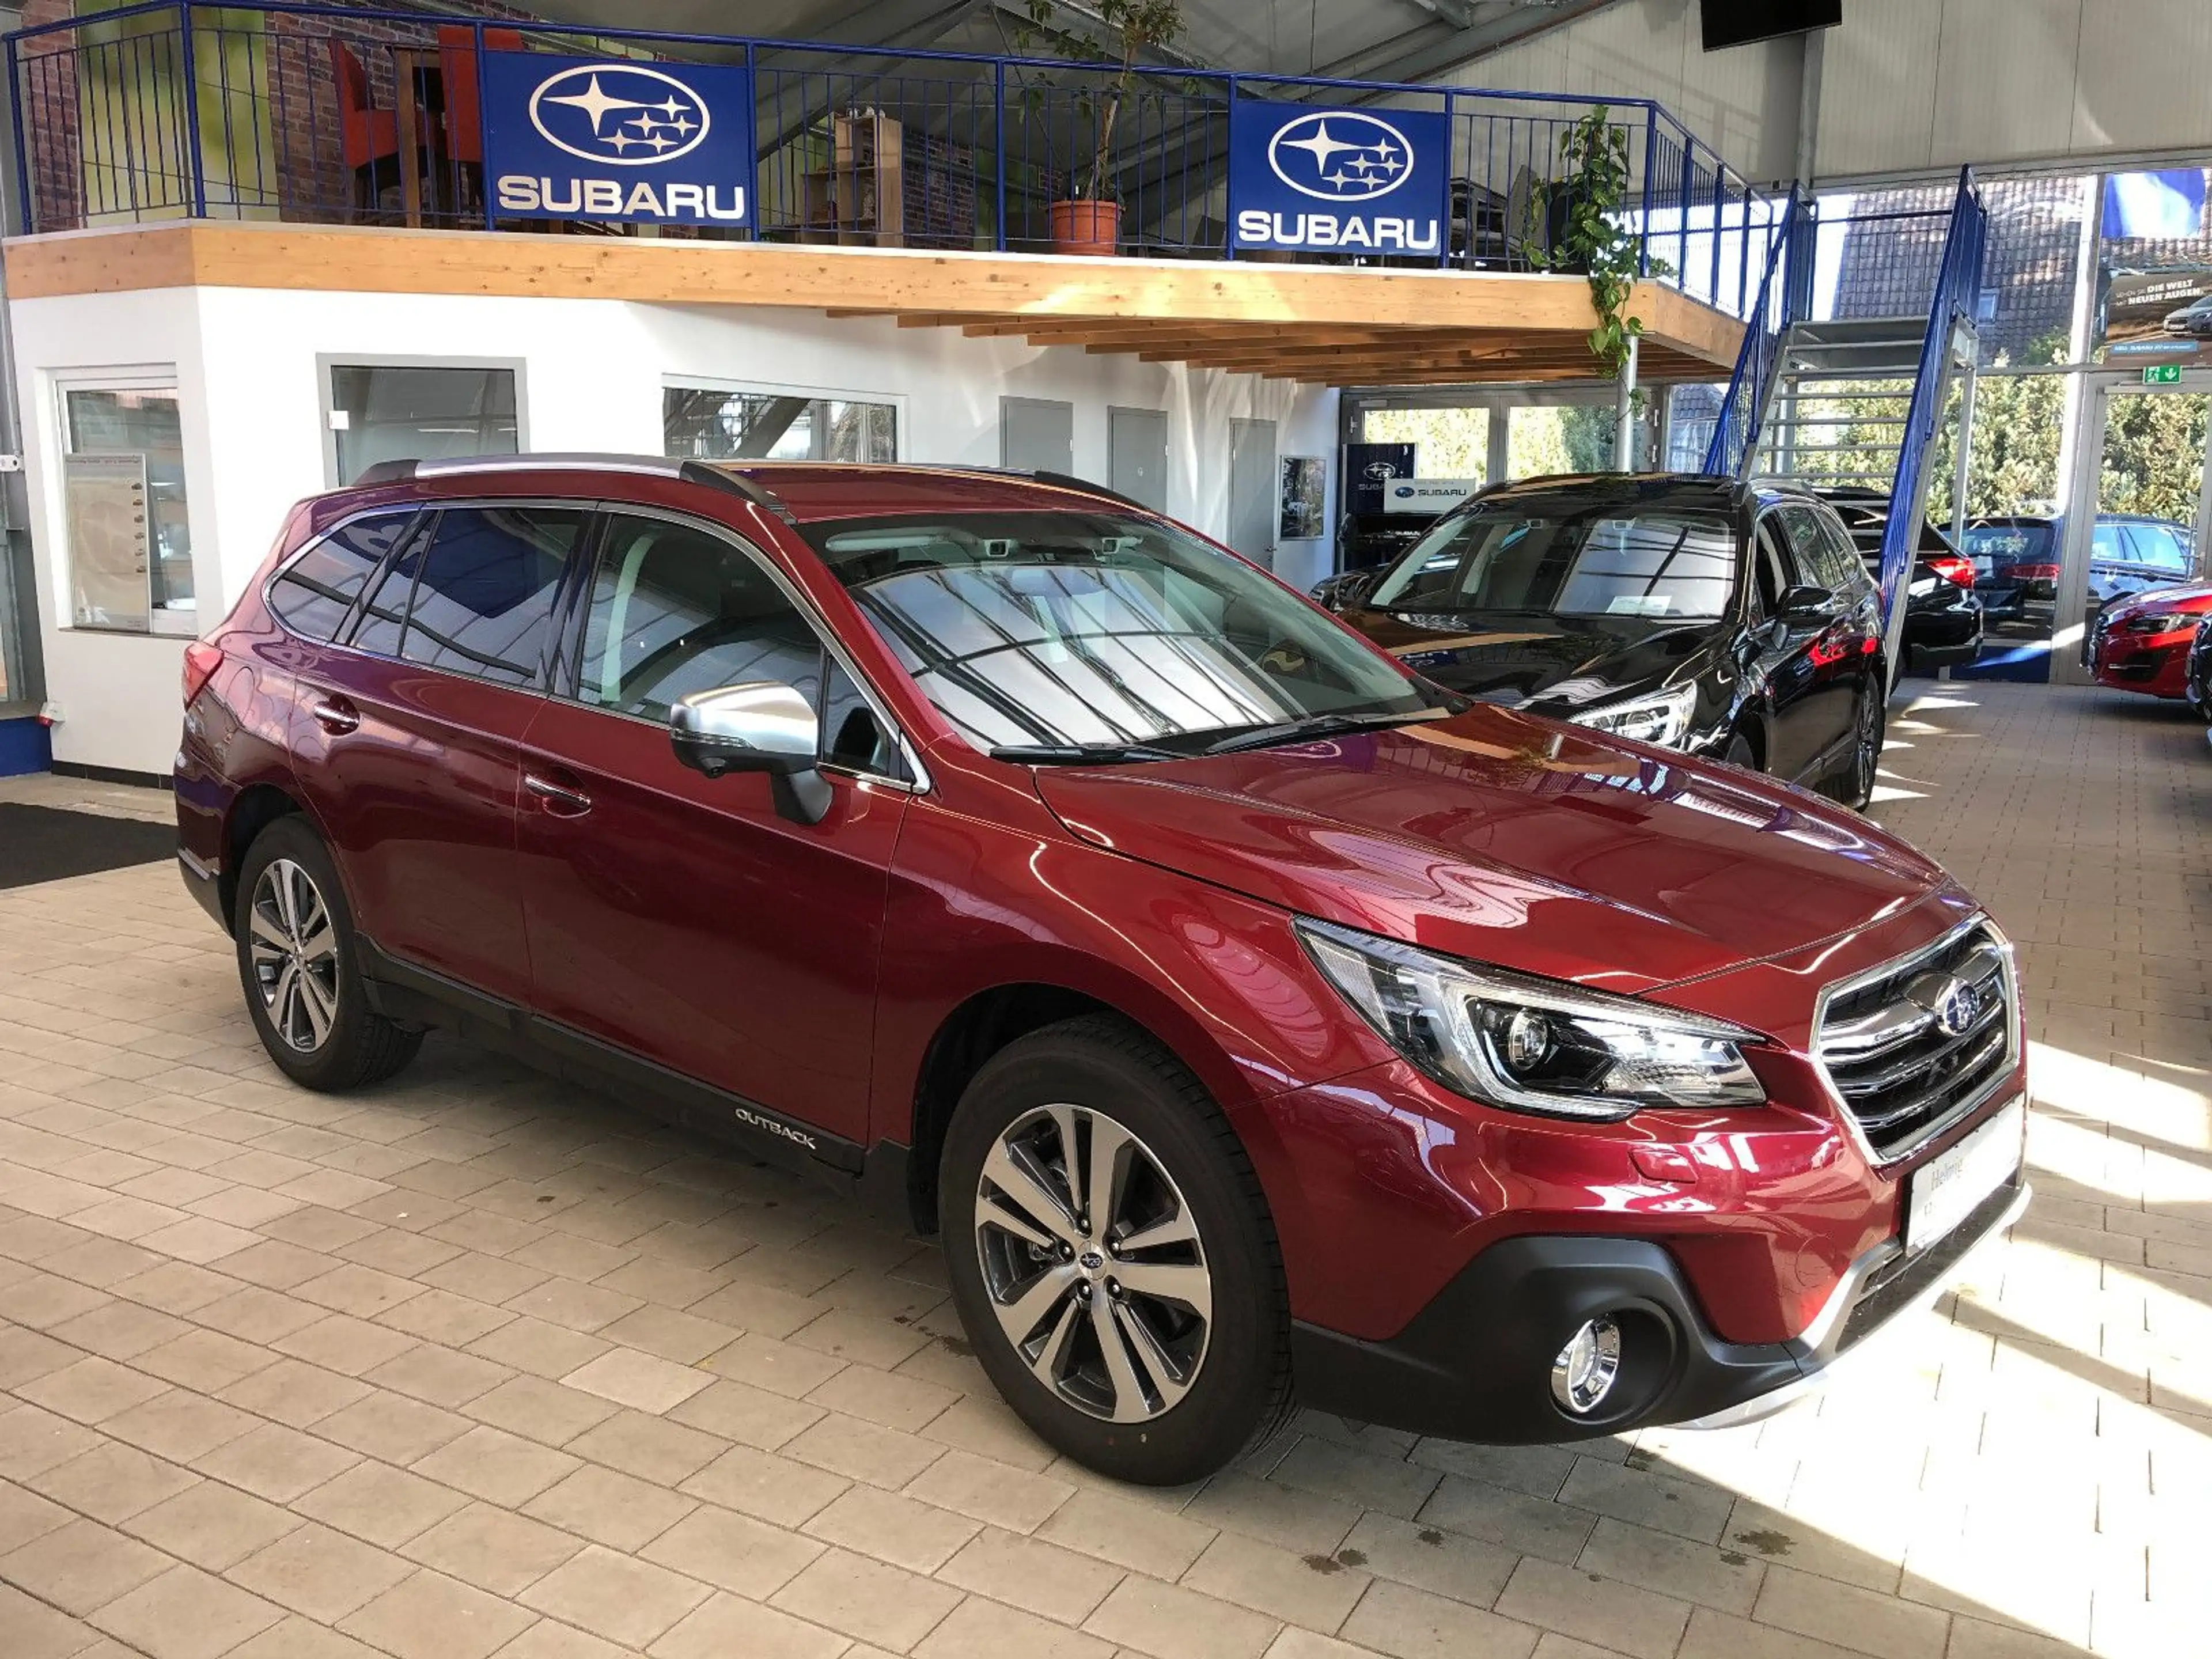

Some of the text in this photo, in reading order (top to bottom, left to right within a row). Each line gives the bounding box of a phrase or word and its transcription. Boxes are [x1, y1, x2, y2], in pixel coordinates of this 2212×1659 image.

[497, 175, 744, 219] SUBARU
[1238, 210, 1437, 249] SUBARU
[2128, 294, 2162, 305] NEUEN
[2147, 283, 2164, 293] DIE
[2166, 279, 2194, 290] WELT
[735, 1108, 816, 1150] OUTBACK
